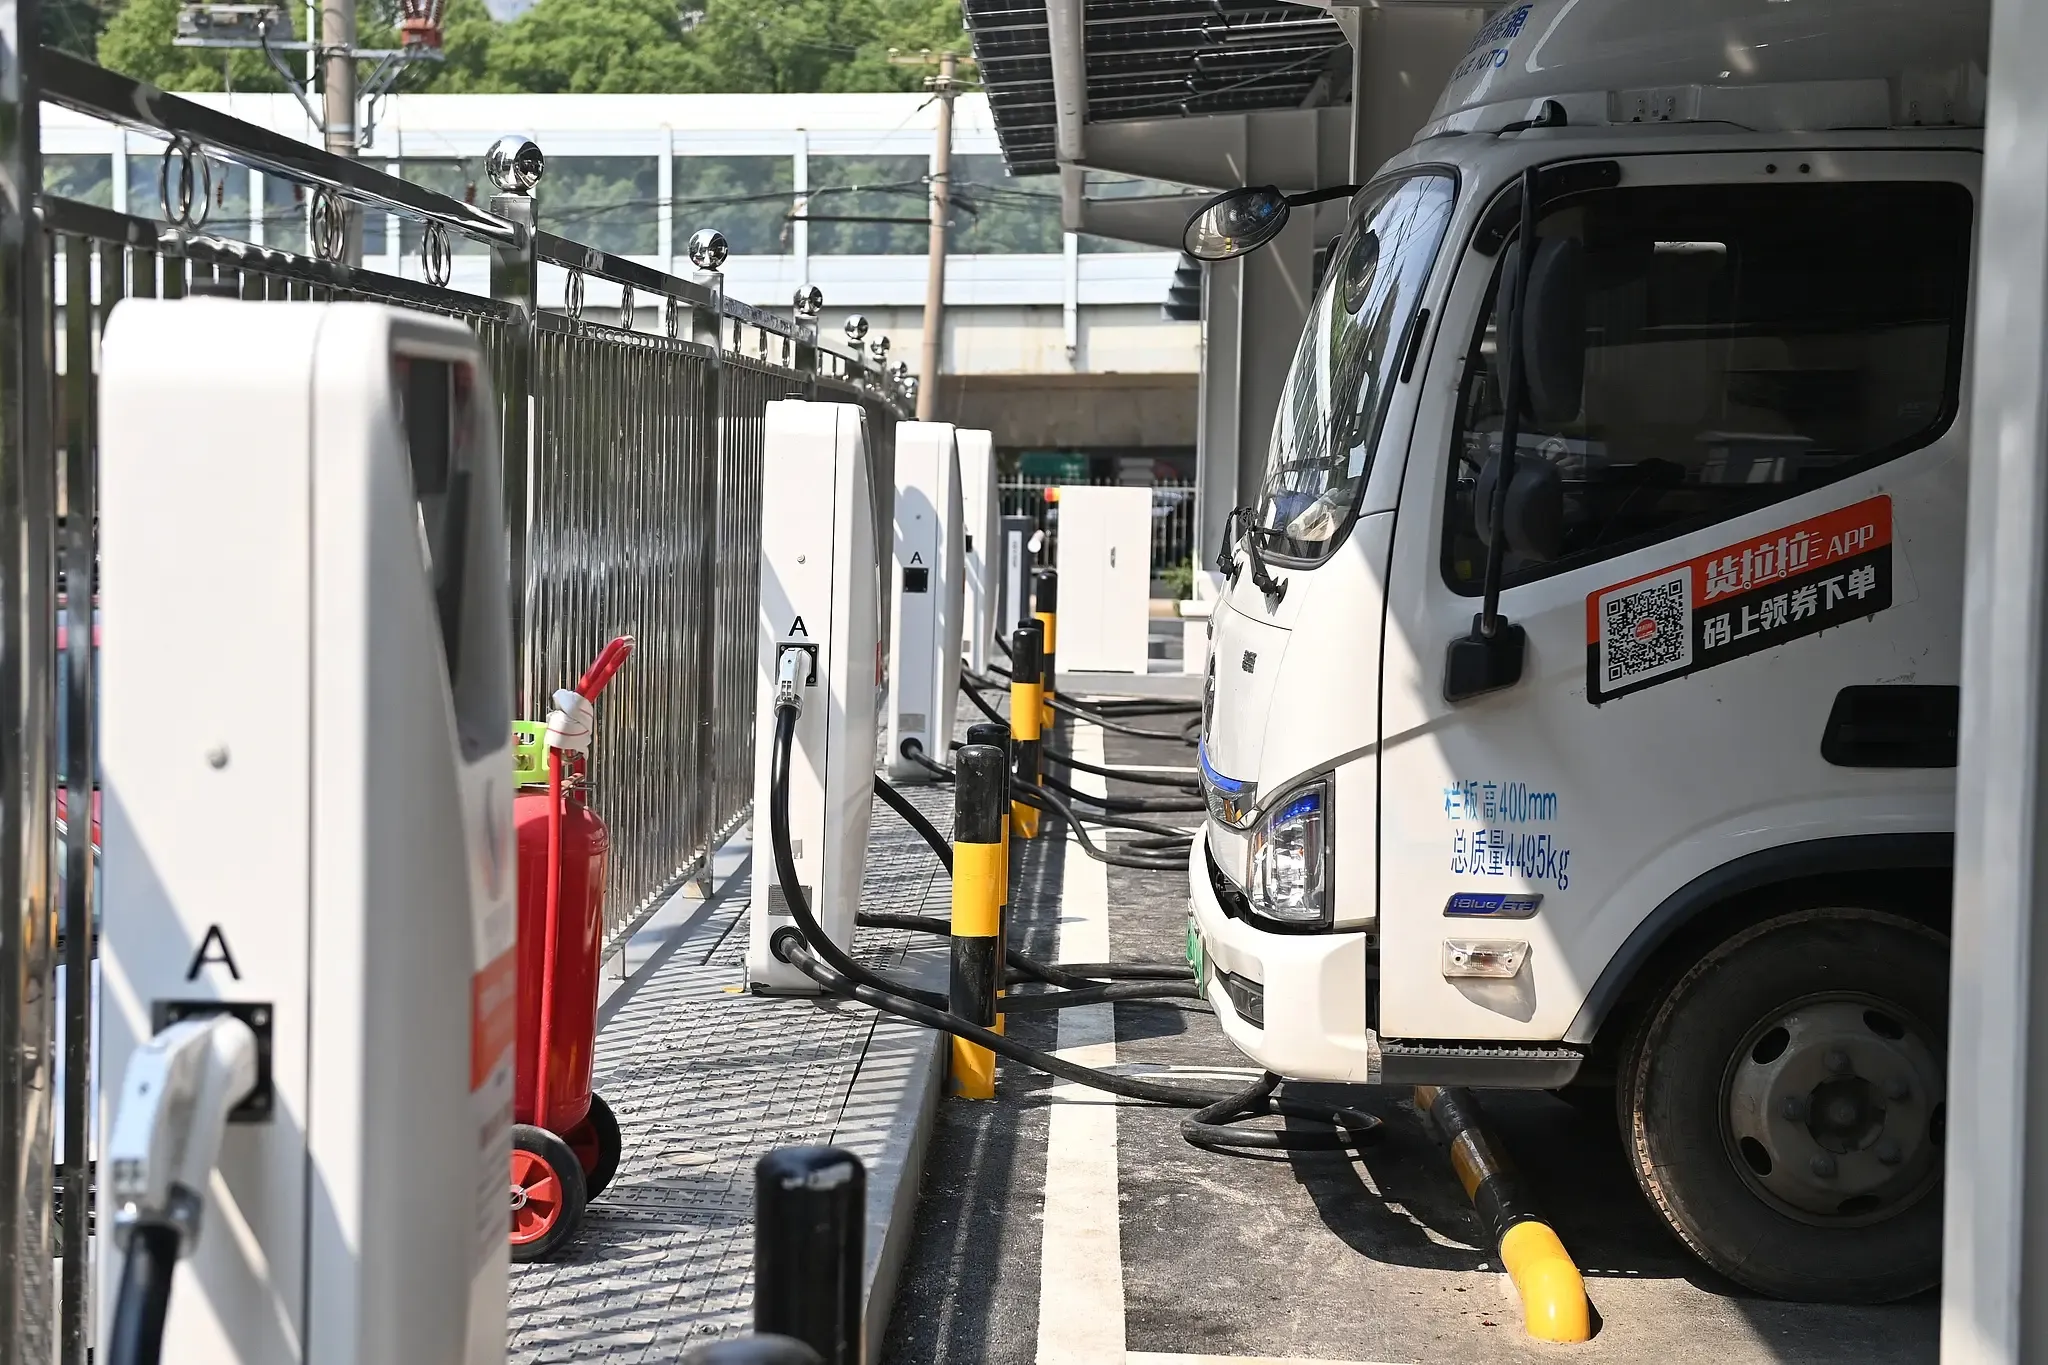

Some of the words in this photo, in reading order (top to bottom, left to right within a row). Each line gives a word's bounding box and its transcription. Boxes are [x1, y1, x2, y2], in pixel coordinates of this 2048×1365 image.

[910, 551, 923, 565] A
[1704, 530, 1813, 600] 货拉拉
[1826, 523, 1874, 560] APP
[788, 615, 809, 637] A
[1703, 564, 1876, 650] 码上领券下单
[1443, 779, 1557, 823] 栏板高400mm
[1451, 828, 1570, 891] 总质量4495kg
[1453, 898, 1498, 909] iBlue
[186, 923, 241, 981] A
